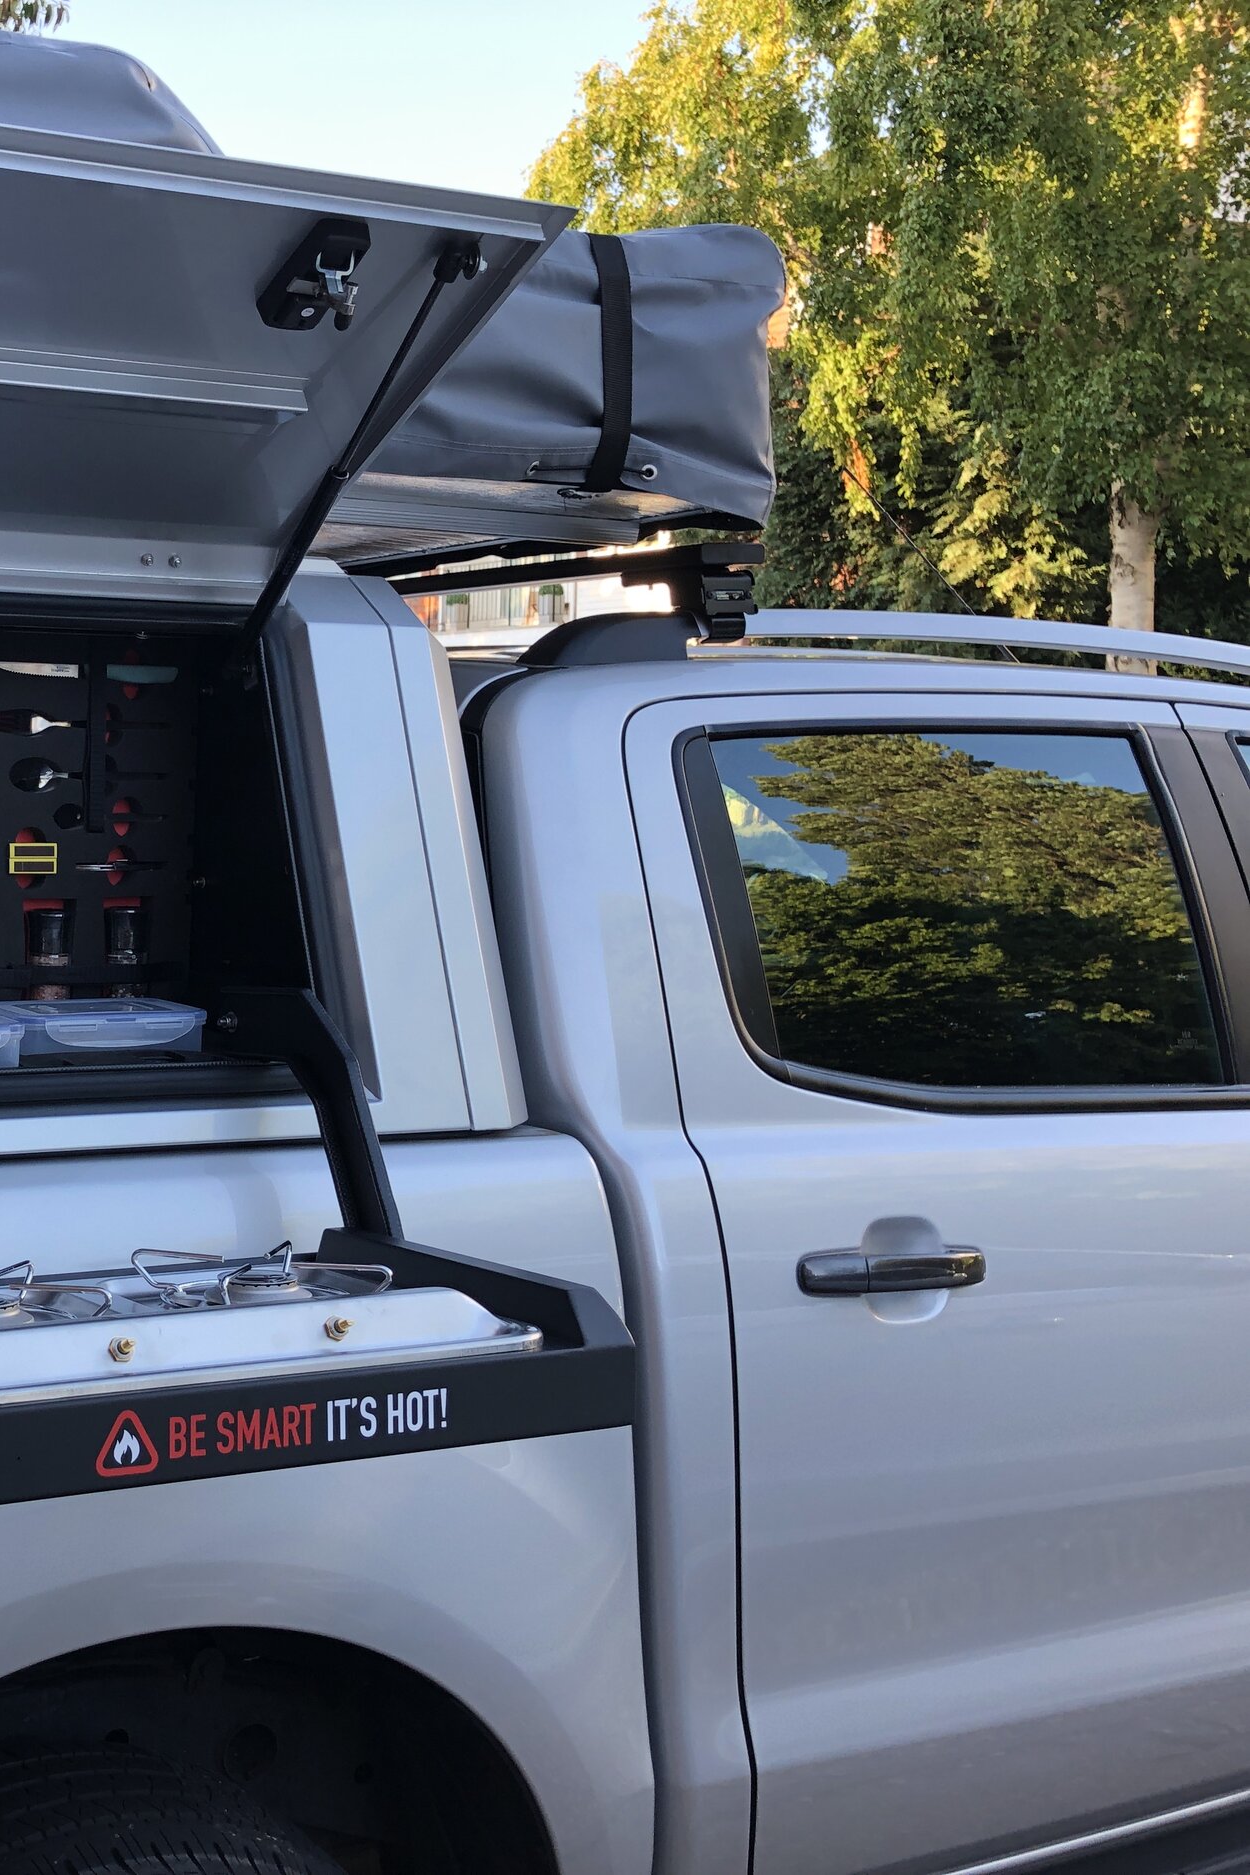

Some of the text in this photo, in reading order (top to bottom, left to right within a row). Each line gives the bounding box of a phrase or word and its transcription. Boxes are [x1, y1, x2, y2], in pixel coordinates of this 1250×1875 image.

[168, 1387, 448, 1460] BE SMART IT'S HOT!
